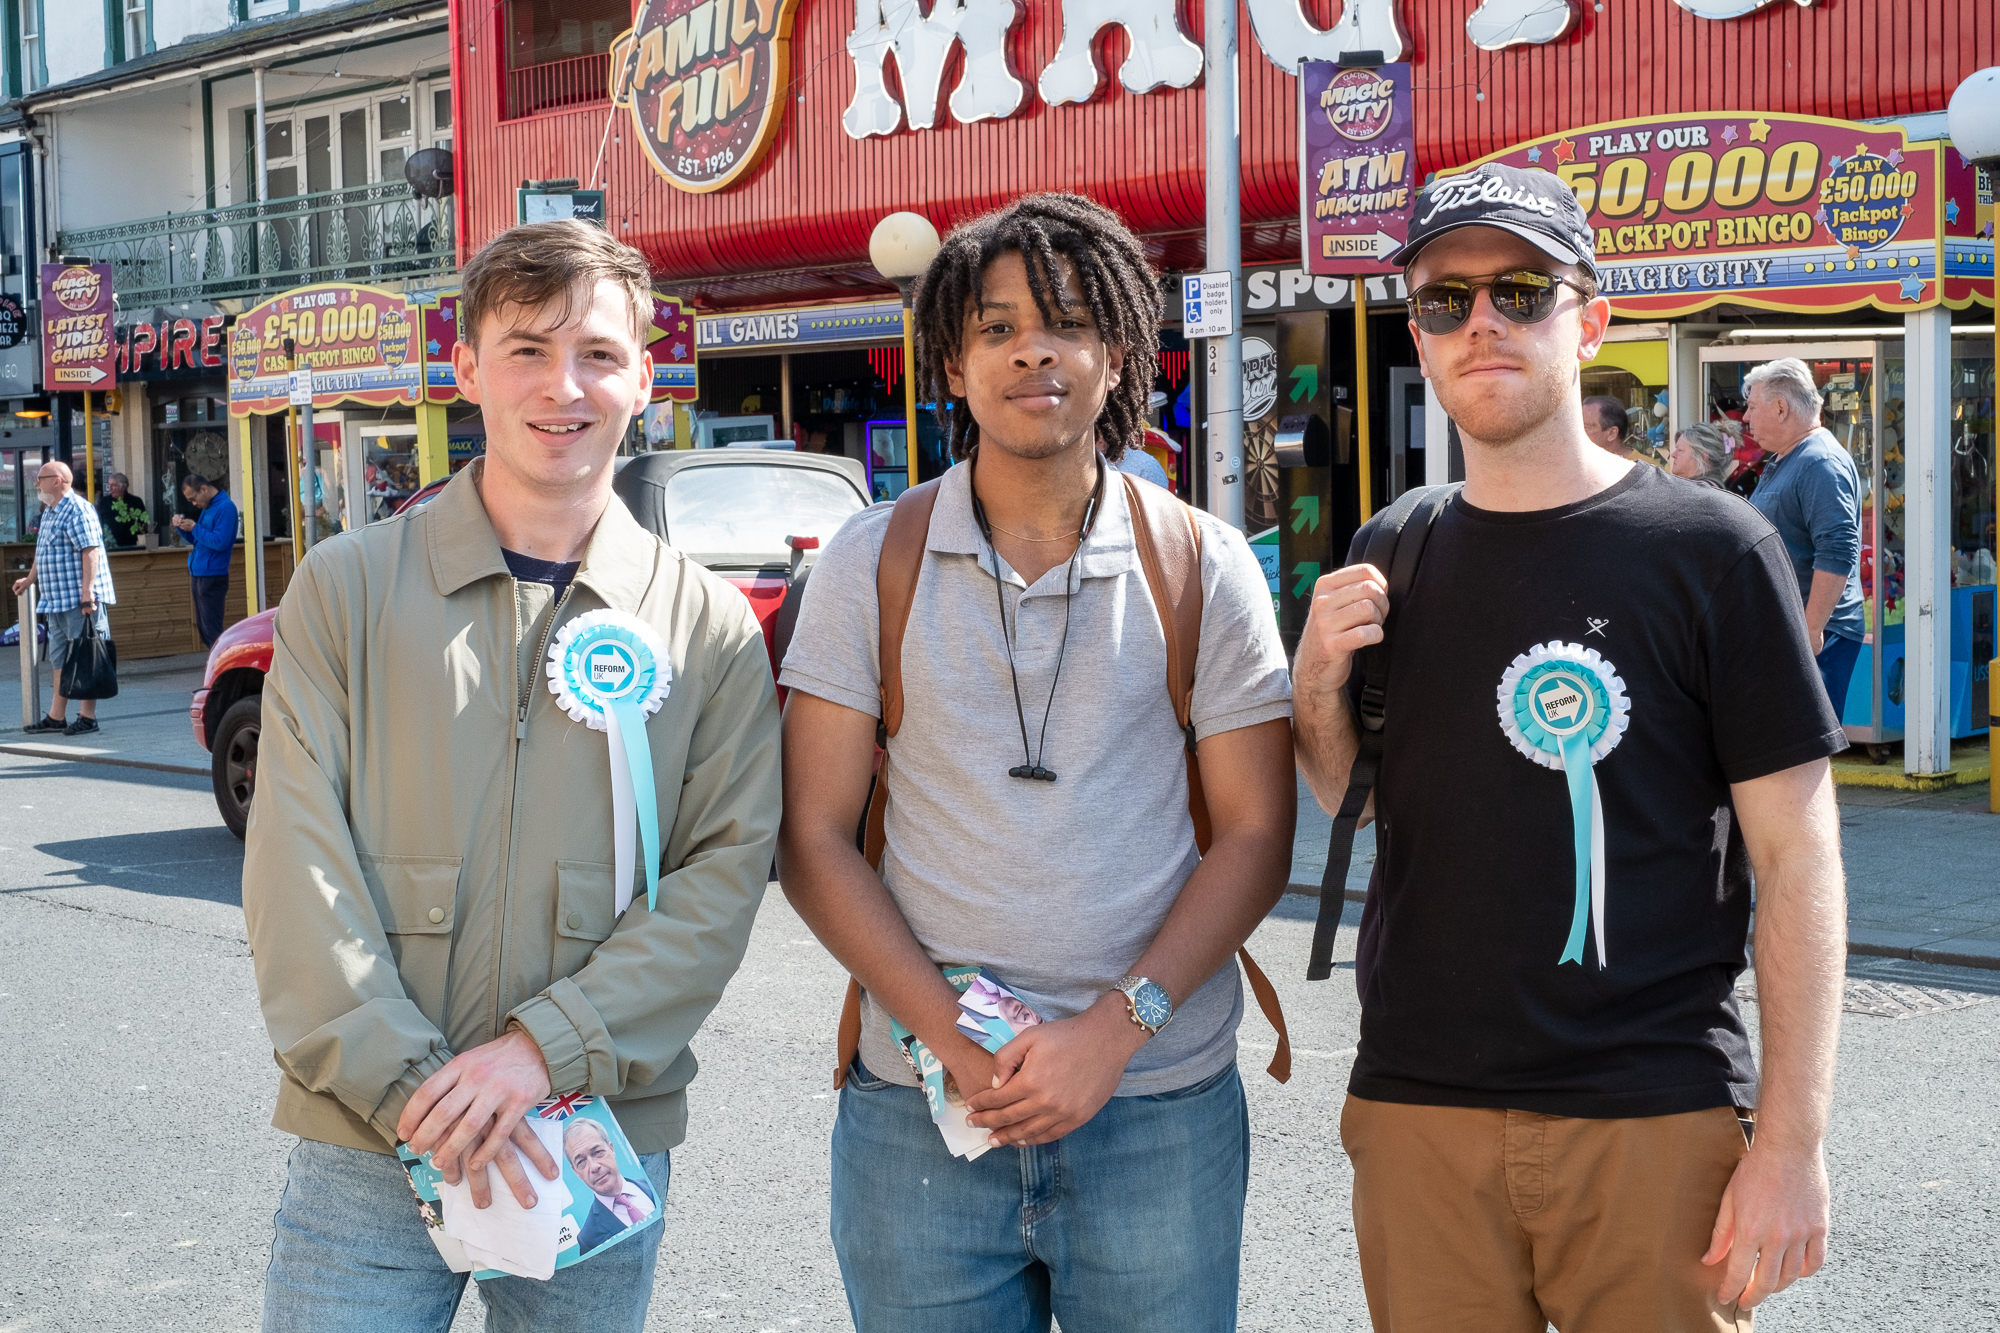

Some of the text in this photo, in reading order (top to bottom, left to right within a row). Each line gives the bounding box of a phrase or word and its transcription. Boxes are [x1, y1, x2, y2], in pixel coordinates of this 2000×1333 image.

[1342, 72, 1370, 81] CLACTON
[657, 46, 755, 143] FUN
[1320, 79, 1394, 108] MAGIC
[1333, 100, 1388, 124] CITY
[1359, 127, 1374, 136] 1926
[1589, 125, 1709, 157] PLAY OUR
[677, 150, 734, 176] EST. 1926
[1845, 159, 1884, 174] PLAY
[1318, 150, 1407, 196] ATM
[1553, 141, 1820, 219] 50,000
[1818, 170, 1918, 204] £50,000
[1315, 188, 1410, 220] MACHINE
[1420, 174, 1558, 226] Titleist
[1832, 206, 1899, 228] Jackpot
[1594, 220, 1711, 255] ACKPOT
[1716, 212, 1812, 246] BINGO
[1841, 226, 1889, 244] Bingo
[1330, 240, 1378, 252] INSIDE
[1696, 259, 1772, 287] CITY
[52, 274, 101, 292] MAGIC
[1202, 281, 1229, 290] Disabled
[60, 286, 97, 301] CITY
[293, 291, 337, 310] PLAY OUR
[1206, 290, 1225, 298] badge
[385, 315, 399, 324] PLAY
[1209, 307, 1223, 315] only
[47, 313, 108, 335] LATEST
[263, 303, 377, 350] £50,000
[377, 321, 412, 341] £50,000
[729, 313, 799, 343] GAMES
[56, 329, 104, 349] VIDEO
[231, 338, 262, 356] £50,000
[382, 342, 406, 355] Jackpot
[51, 343, 109, 365] GAMES
[236, 356, 257, 369] Jackpot
[342, 345, 376, 366] BINGO
[385, 354, 403, 366] Bingo
[60, 370, 92, 379] INSIDE
[312, 376, 336, 392] GIC
[336, 373, 363, 390] CITY
[593, 664, 626, 673] REFORM
[593, 672, 604, 680] UK
[1545, 694, 1578, 710] REFORM
[1547, 709, 1559, 719] UK
